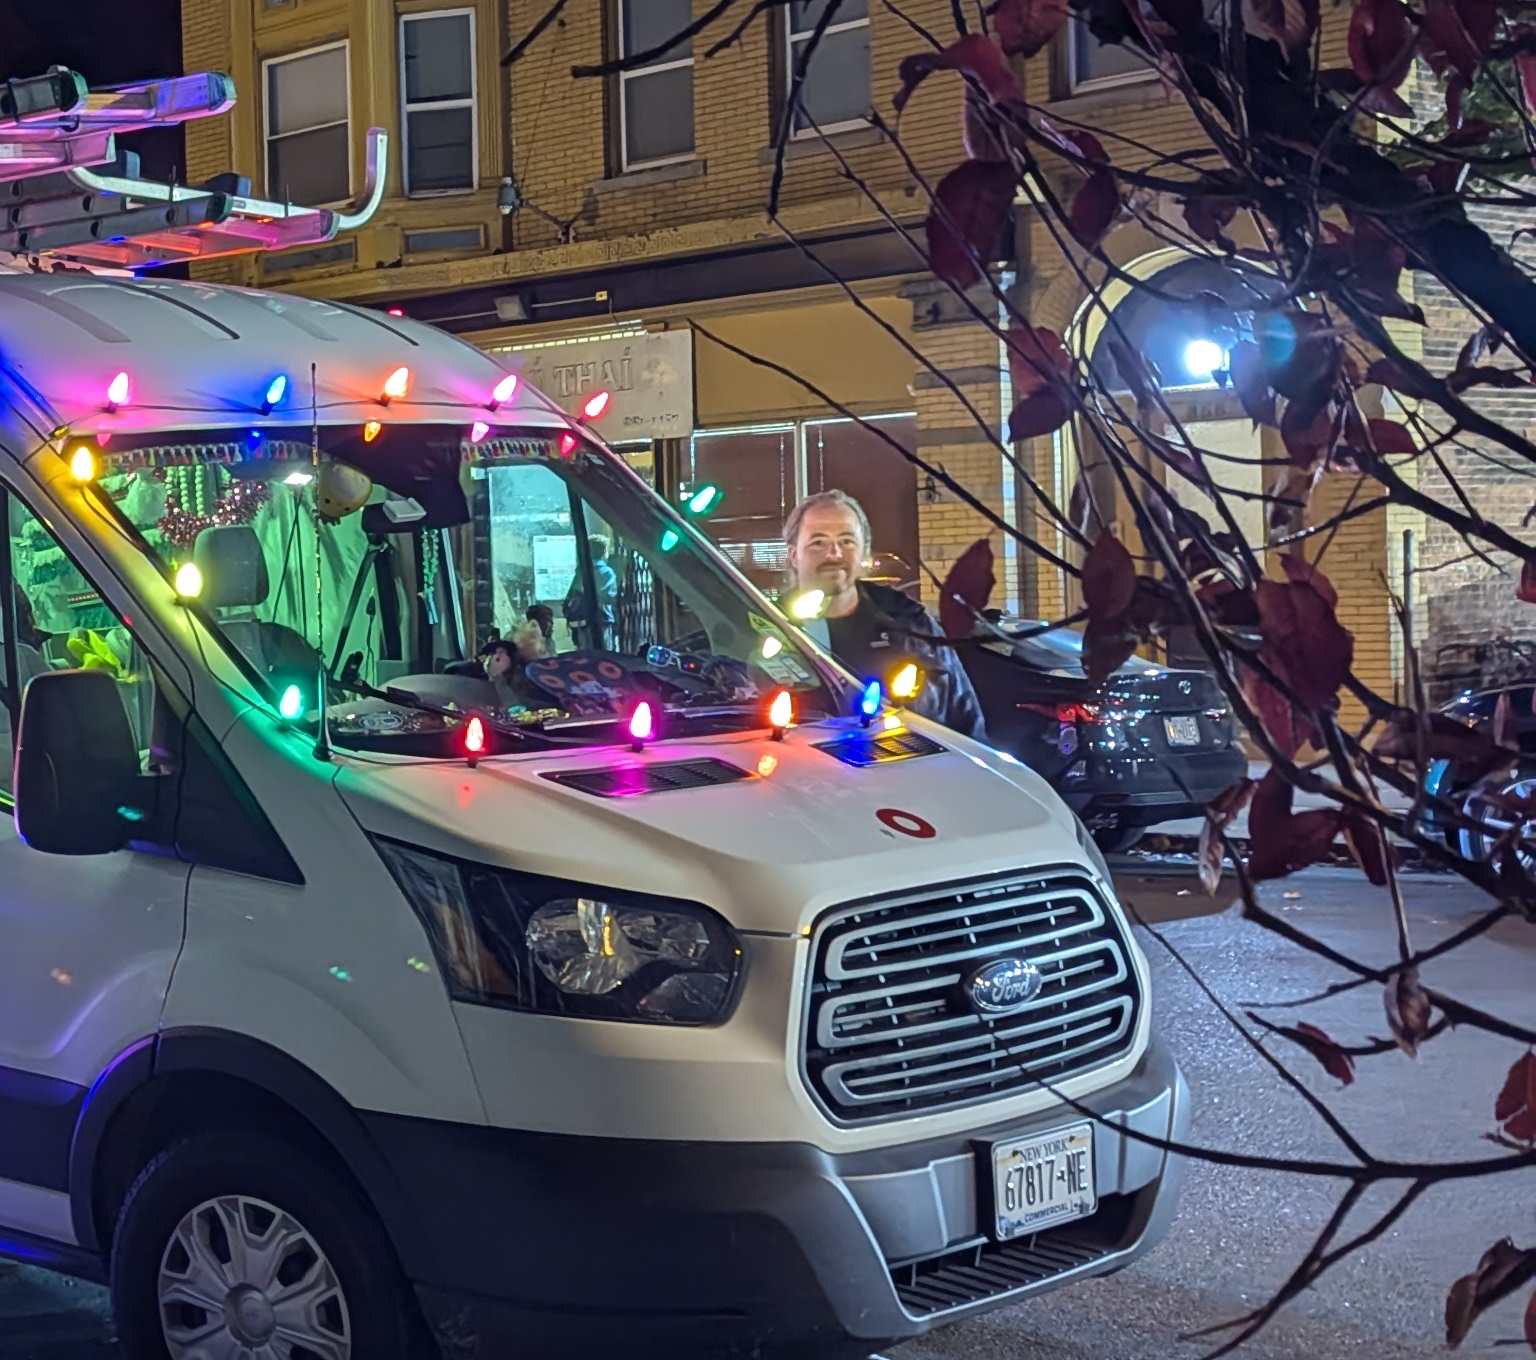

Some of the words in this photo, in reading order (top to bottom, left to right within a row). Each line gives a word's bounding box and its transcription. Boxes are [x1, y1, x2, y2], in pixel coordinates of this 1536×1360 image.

[992, 971, 1031, 1003] Ford
[1020, 1145, 1041, 1163] NEW
[1044, 1139, 1068, 1155] YORK
[1024, 1202, 1069, 1223] COMMERCIAL
